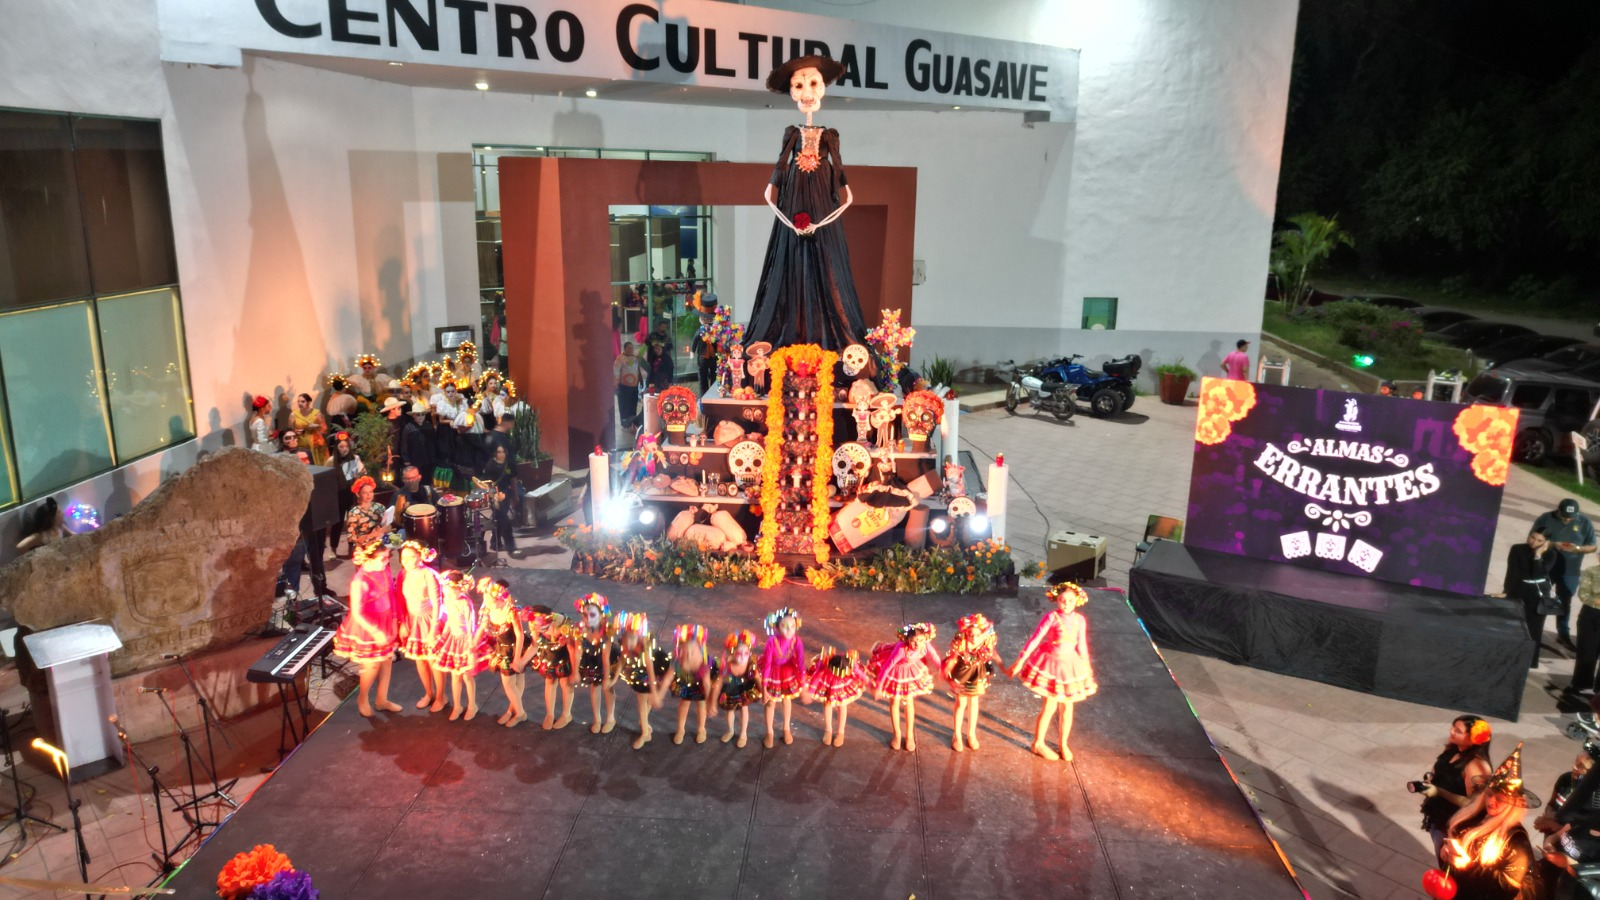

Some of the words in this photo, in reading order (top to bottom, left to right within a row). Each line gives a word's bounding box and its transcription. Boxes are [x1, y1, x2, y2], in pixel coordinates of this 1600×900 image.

[904, 38, 1048, 103] GUASAVE
[1253, 442, 1441, 506] ERRANTES
[1310, 437, 1386, 465] ALMAS
